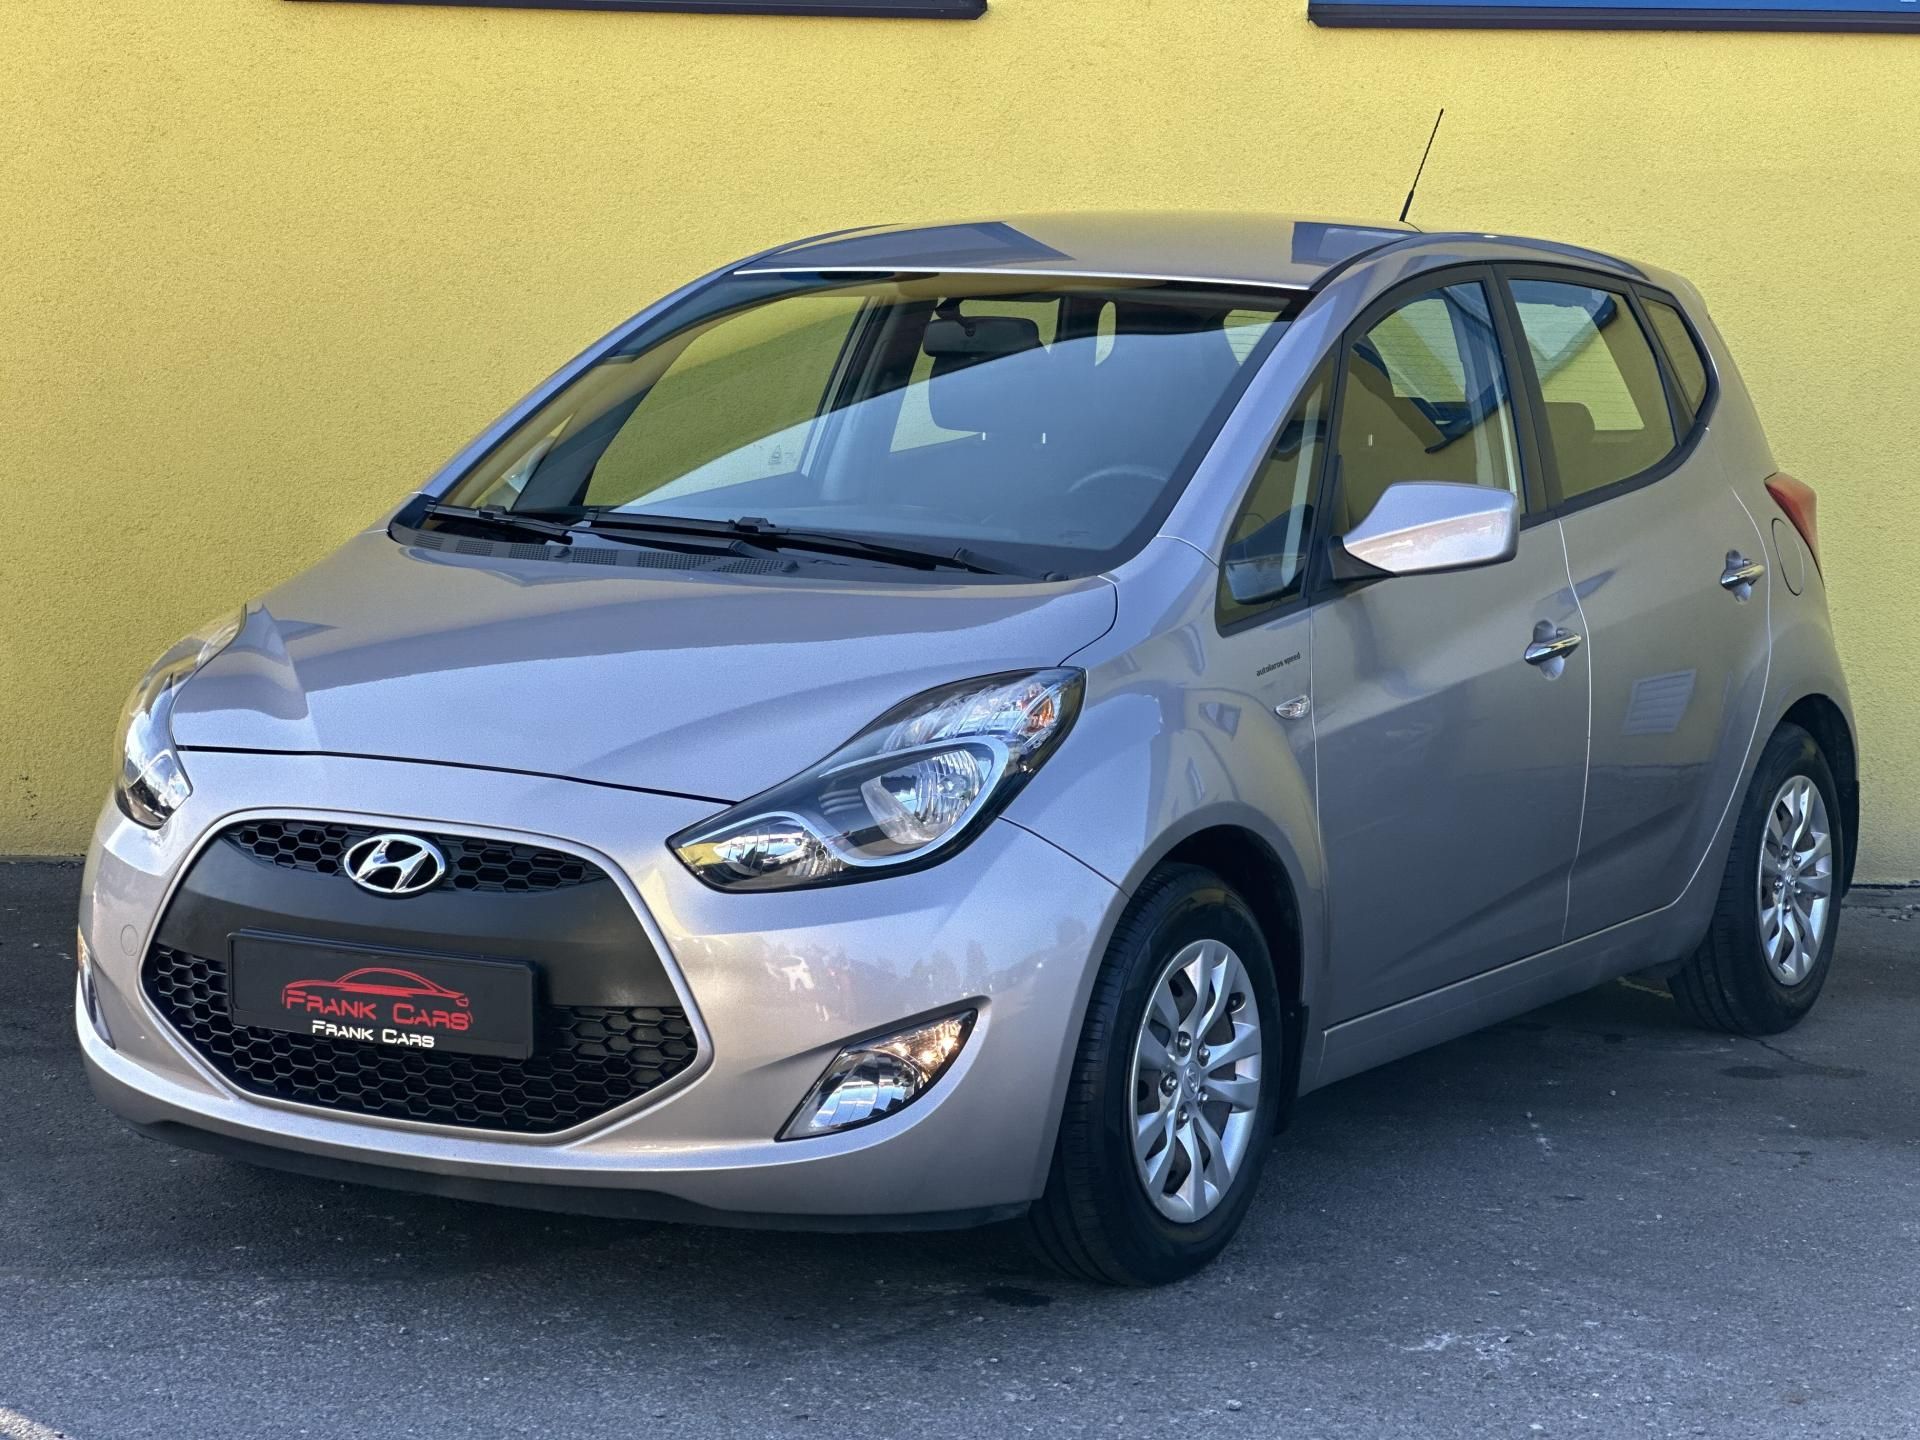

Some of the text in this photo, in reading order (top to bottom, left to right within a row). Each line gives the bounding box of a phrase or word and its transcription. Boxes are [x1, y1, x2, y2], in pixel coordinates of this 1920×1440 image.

[286, 989, 470, 1031] FRANK CARS
[311, 1019, 435, 1048] FRANK CARS
